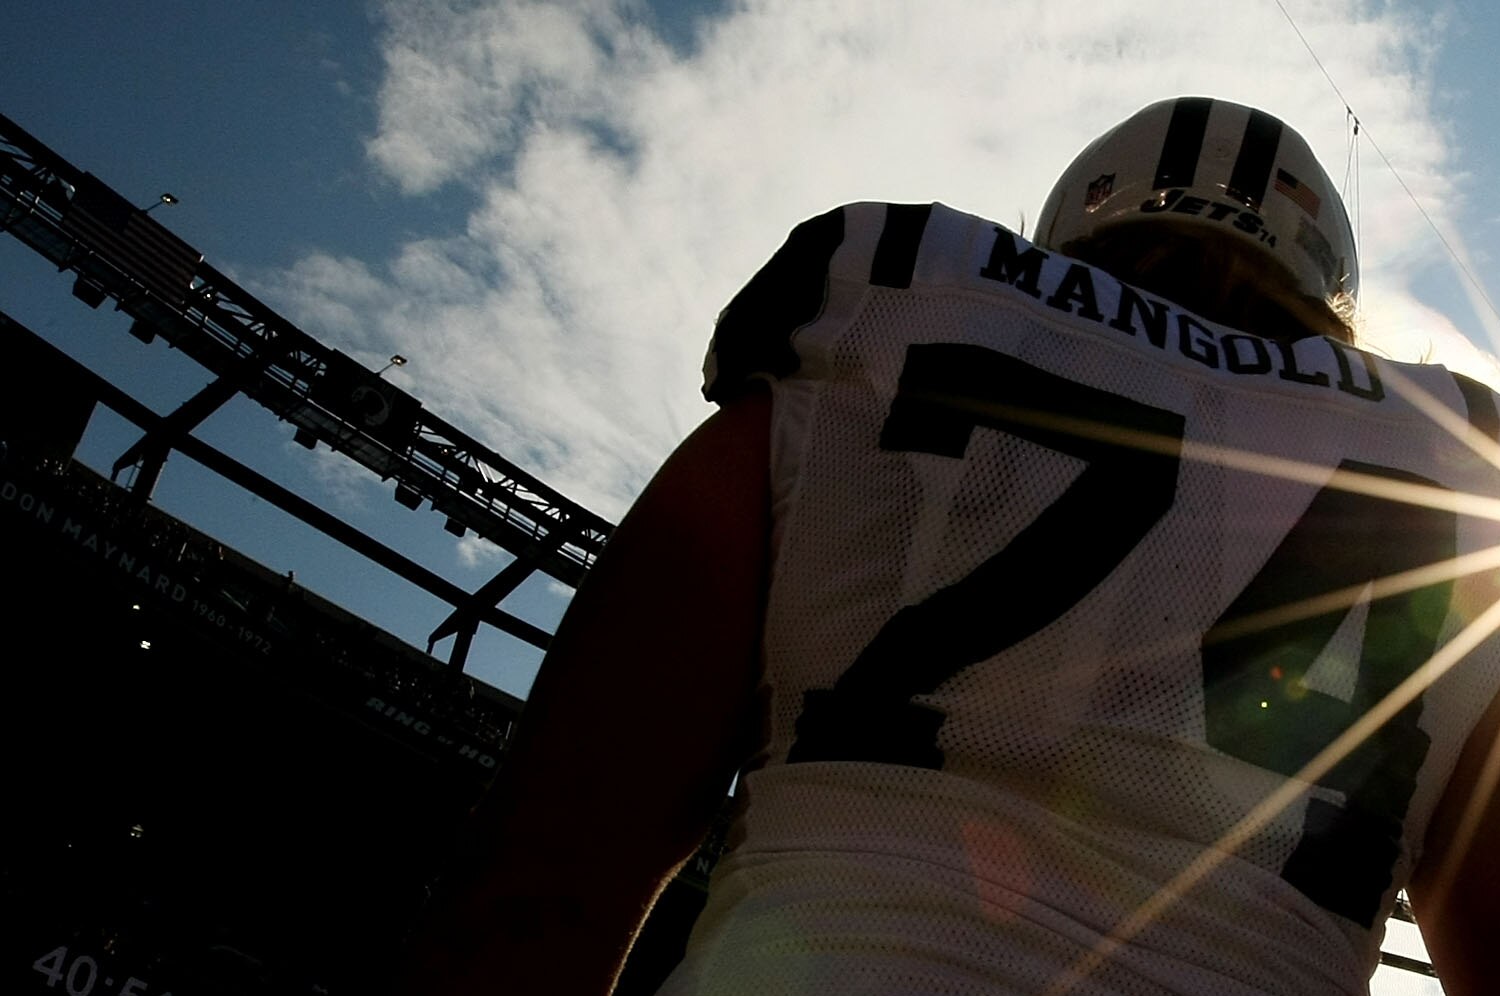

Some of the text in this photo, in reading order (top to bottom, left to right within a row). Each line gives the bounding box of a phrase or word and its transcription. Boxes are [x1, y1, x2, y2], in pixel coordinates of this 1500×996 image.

[1140, 188, 1265, 234] JETS
[1259, 228, 1277, 249] 74
[980, 225, 1387, 403] MANGOLD
[61, 515, 189, 603] MAYNARD
[788, 341, 1458, 929] 74
